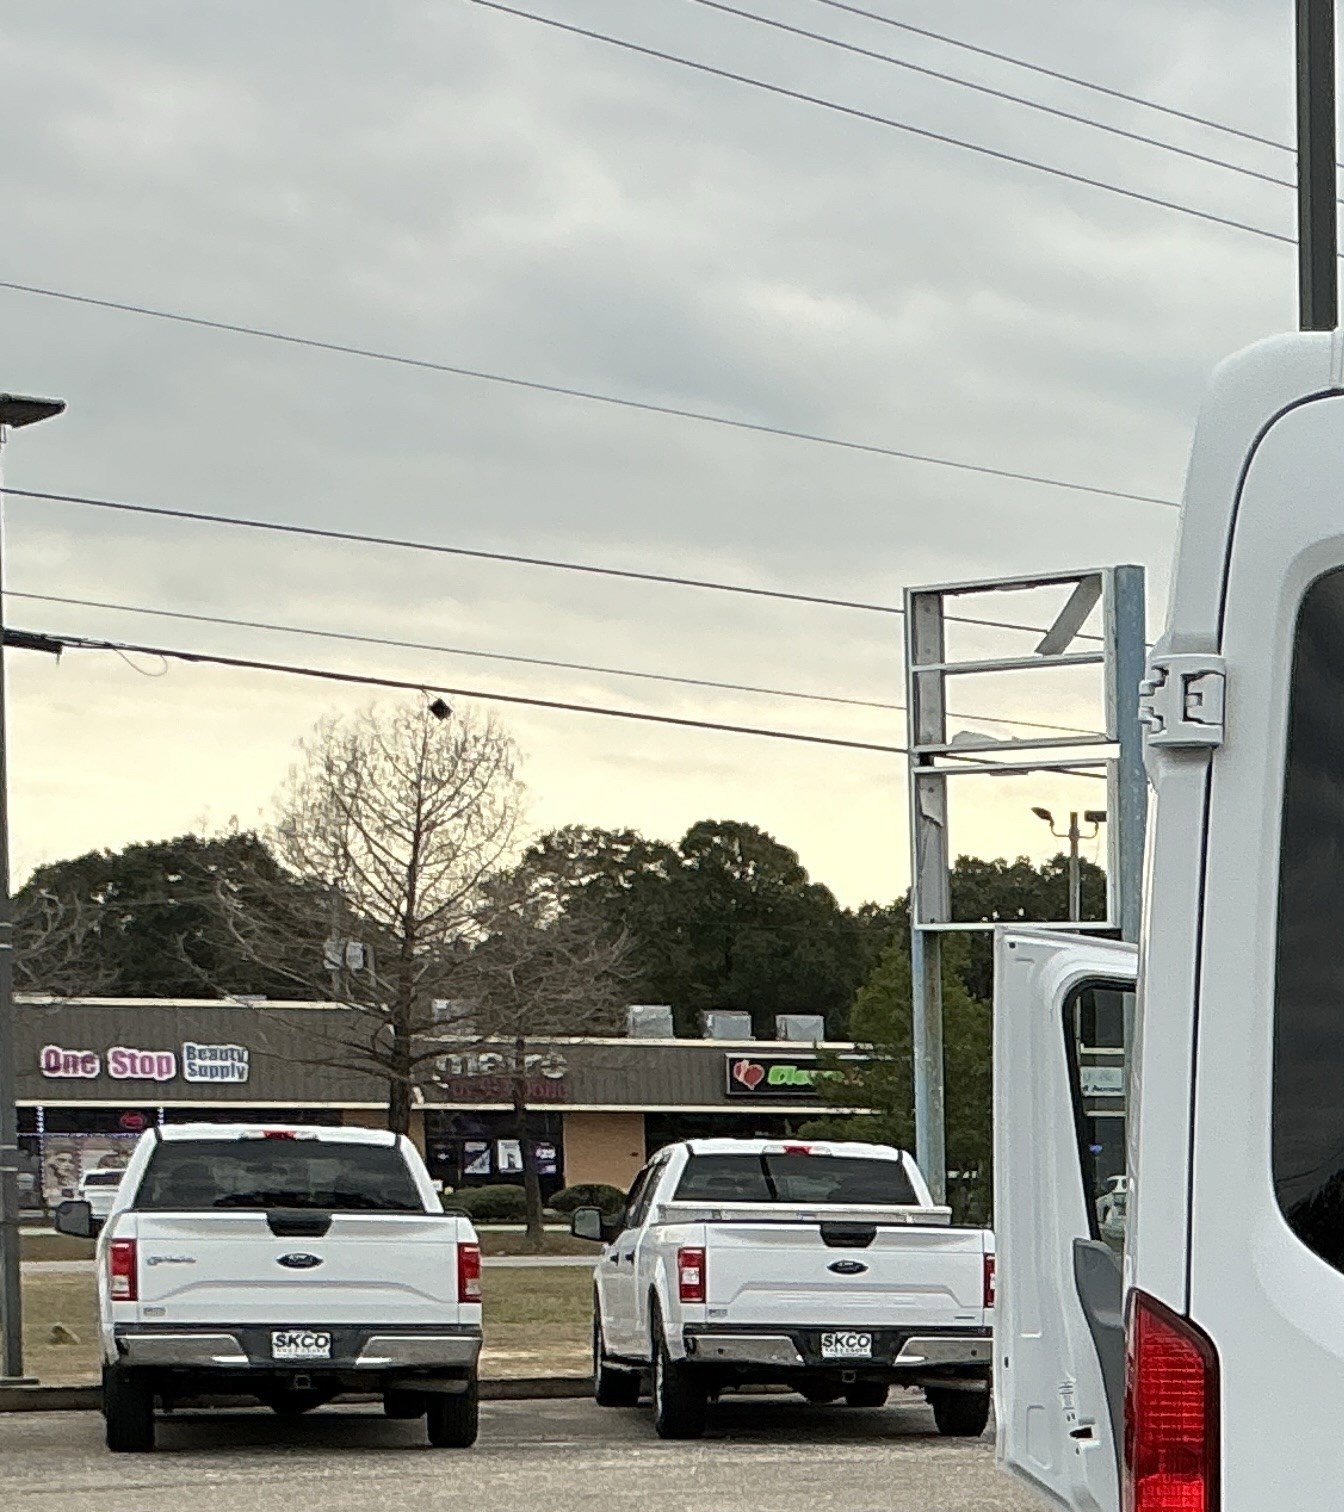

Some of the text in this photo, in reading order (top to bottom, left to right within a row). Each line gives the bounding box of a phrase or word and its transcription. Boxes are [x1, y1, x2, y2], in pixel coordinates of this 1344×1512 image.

[186, 1045, 246, 1062] Beauty
[42, 1047, 174, 1079] One Stop
[186, 1062, 246, 1079] Supply
[273, 1334, 330, 1348] SKCO
[822, 1334, 871, 1348] SKCO
